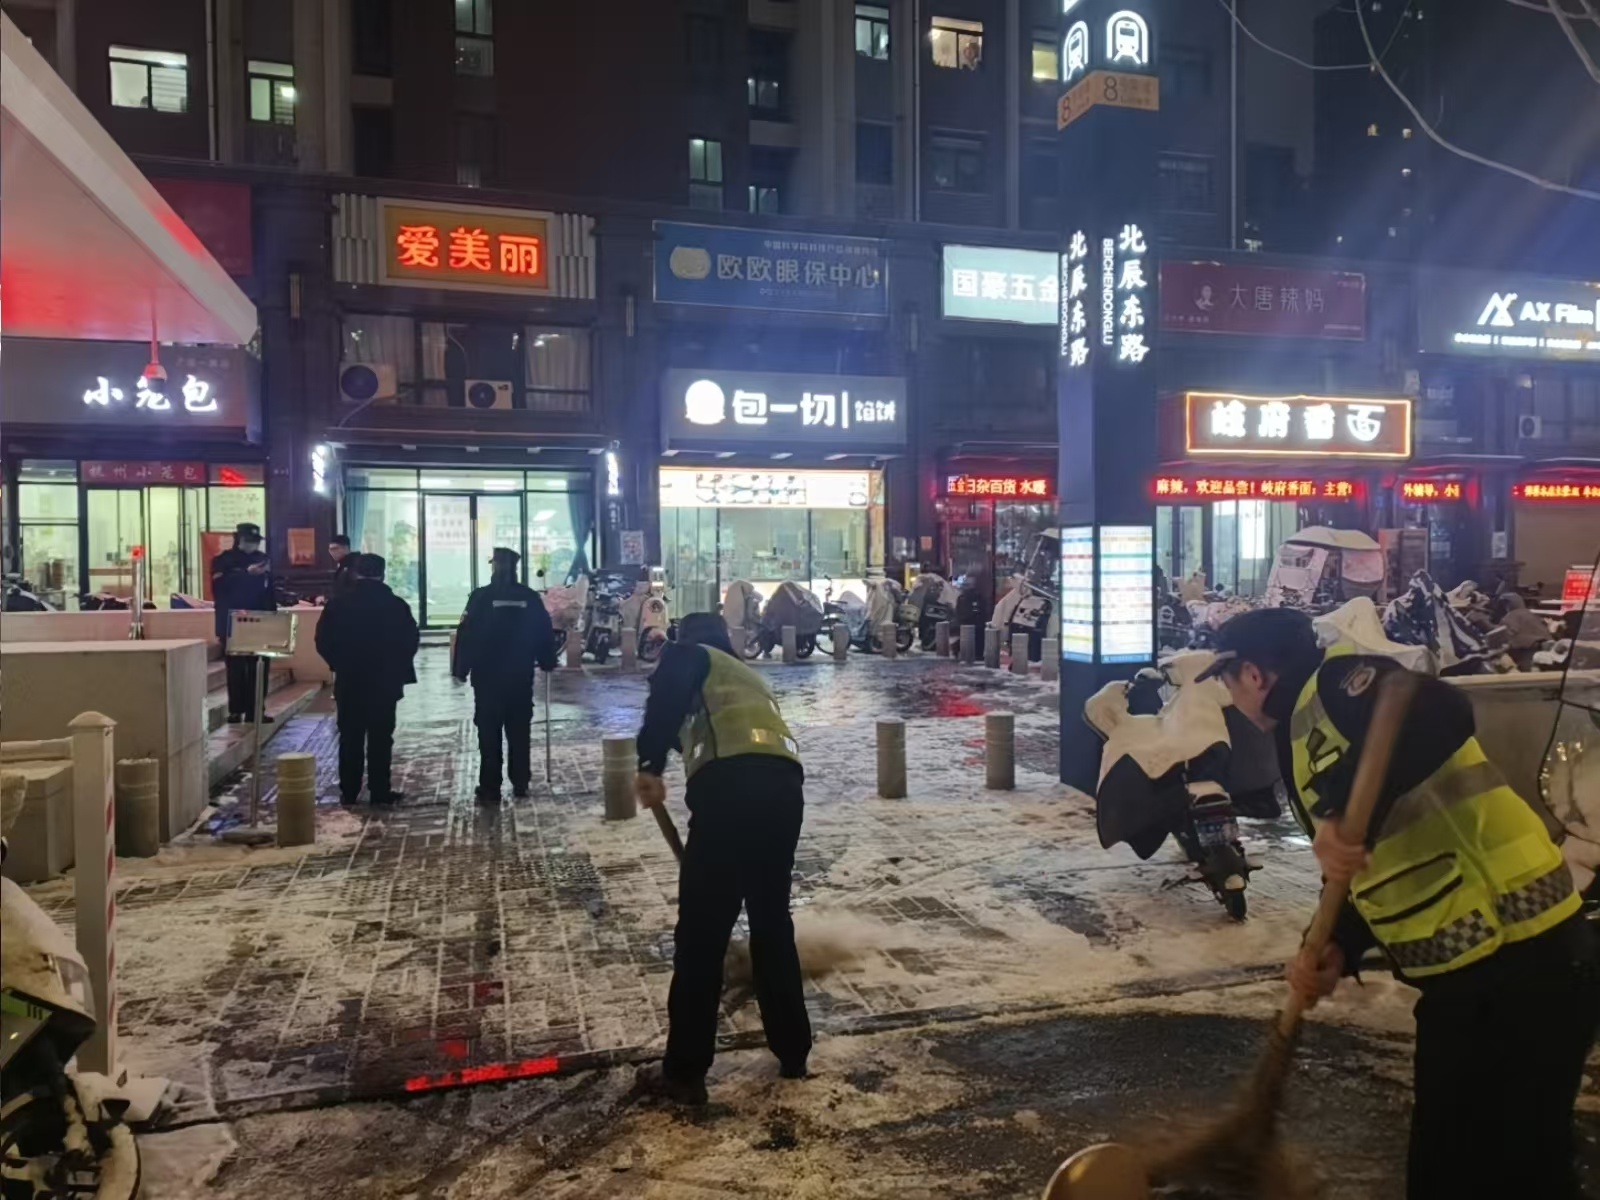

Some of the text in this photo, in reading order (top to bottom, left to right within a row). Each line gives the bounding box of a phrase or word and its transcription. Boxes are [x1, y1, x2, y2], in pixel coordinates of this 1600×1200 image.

[1104, 76, 1118, 101] 8
[397, 225, 540, 274] 爱美丽
[717, 254, 879, 289] 欧欧眼保中心
[1103, 238, 1114, 345] BEICHENDONGLU
[1119, 224, 1150, 361] 北辰东路
[1229, 284, 1325, 313] 大唐辣妈
[1520, 301, 1551, 322] AX
[733, 389, 836, 427] 包一切
